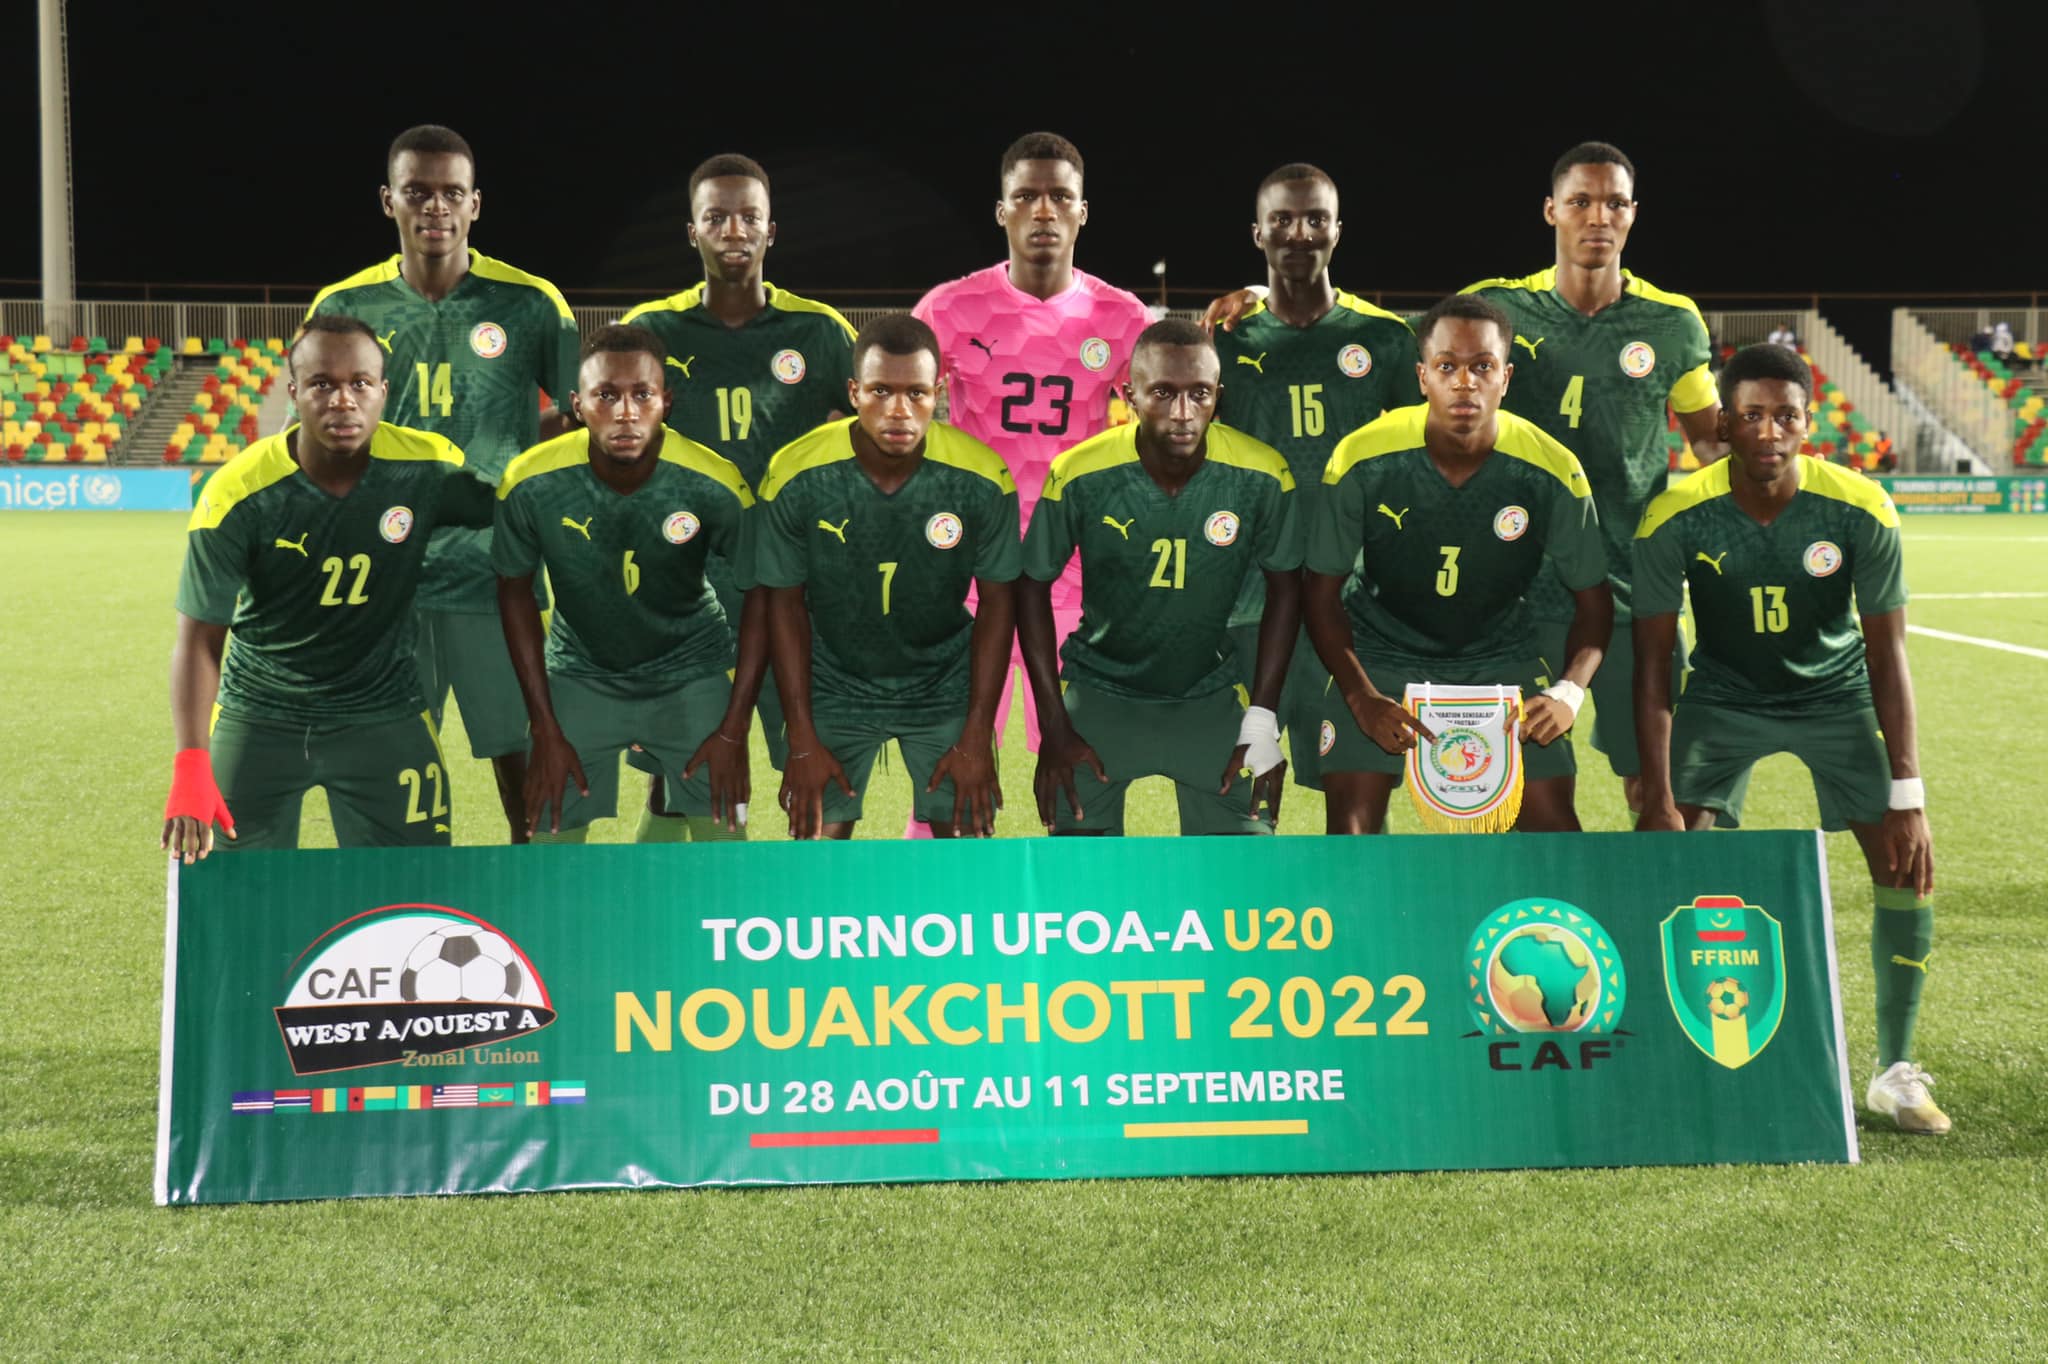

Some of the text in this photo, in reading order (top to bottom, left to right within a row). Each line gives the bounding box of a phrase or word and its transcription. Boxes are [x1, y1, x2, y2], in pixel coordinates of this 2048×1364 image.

[416, 362, 453, 417] 14
[715, 386, 752, 441] 19
[1000, 372, 1074, 436] 23
[1288, 383, 1325, 438] 15
[1560, 375, 1584, 429] 4
[319, 553, 372, 607] 22
[623, 550, 640, 597] 6
[878, 562, 899, 615] 7
[1149, 538, 1187, 590] 21
[1435, 546, 1461, 598] 3
[1750, 586, 1789, 634] 13
[399, 762, 448, 824] 22
[702, 907, 1334, 961] TOURNOI UFOA-A U20
[1691, 949, 1760, 966] FFRIM
[308, 967, 393, 1000] CAF
[286, 1009, 540, 1048] WEST A/OUEST A
[615, 974, 1429, 1052] NOUAKCHOTT 2022
[402, 1048, 540, 1068] Zonal Union
[1488, 1039, 1612, 1071] CAF
[709, 1069, 1345, 1115] DU 28 AOÛT AU 11 SEPTEMBRE
